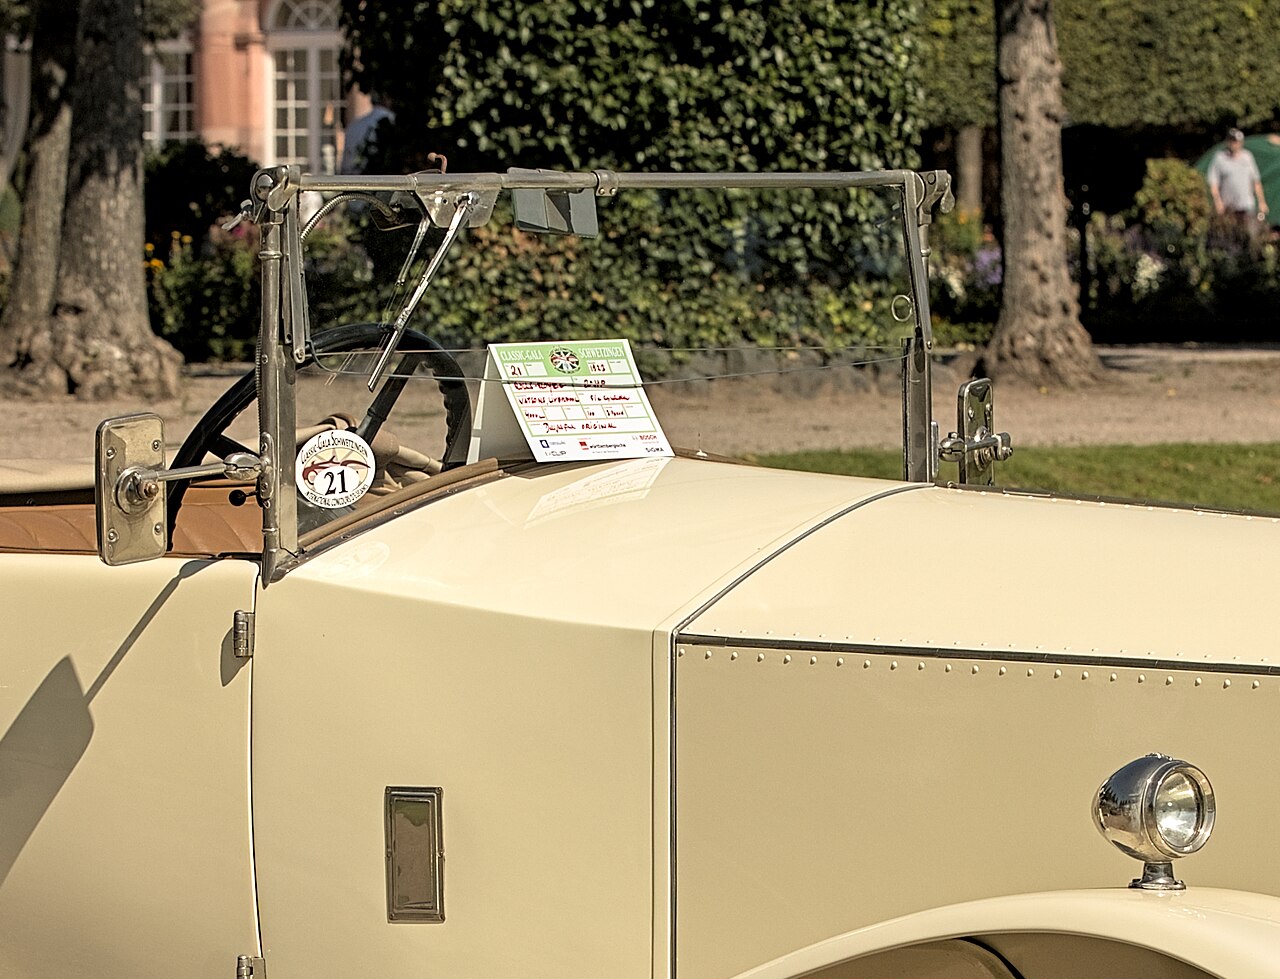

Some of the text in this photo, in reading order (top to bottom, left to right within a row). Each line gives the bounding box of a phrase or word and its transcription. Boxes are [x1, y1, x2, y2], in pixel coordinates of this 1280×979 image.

[500, 350, 545, 361] CLASSIC-GALA
[578, 347, 625, 359] SCHWETZINGEN
[511, 365, 523, 376] 21
[324, 469, 349, 496] 21
